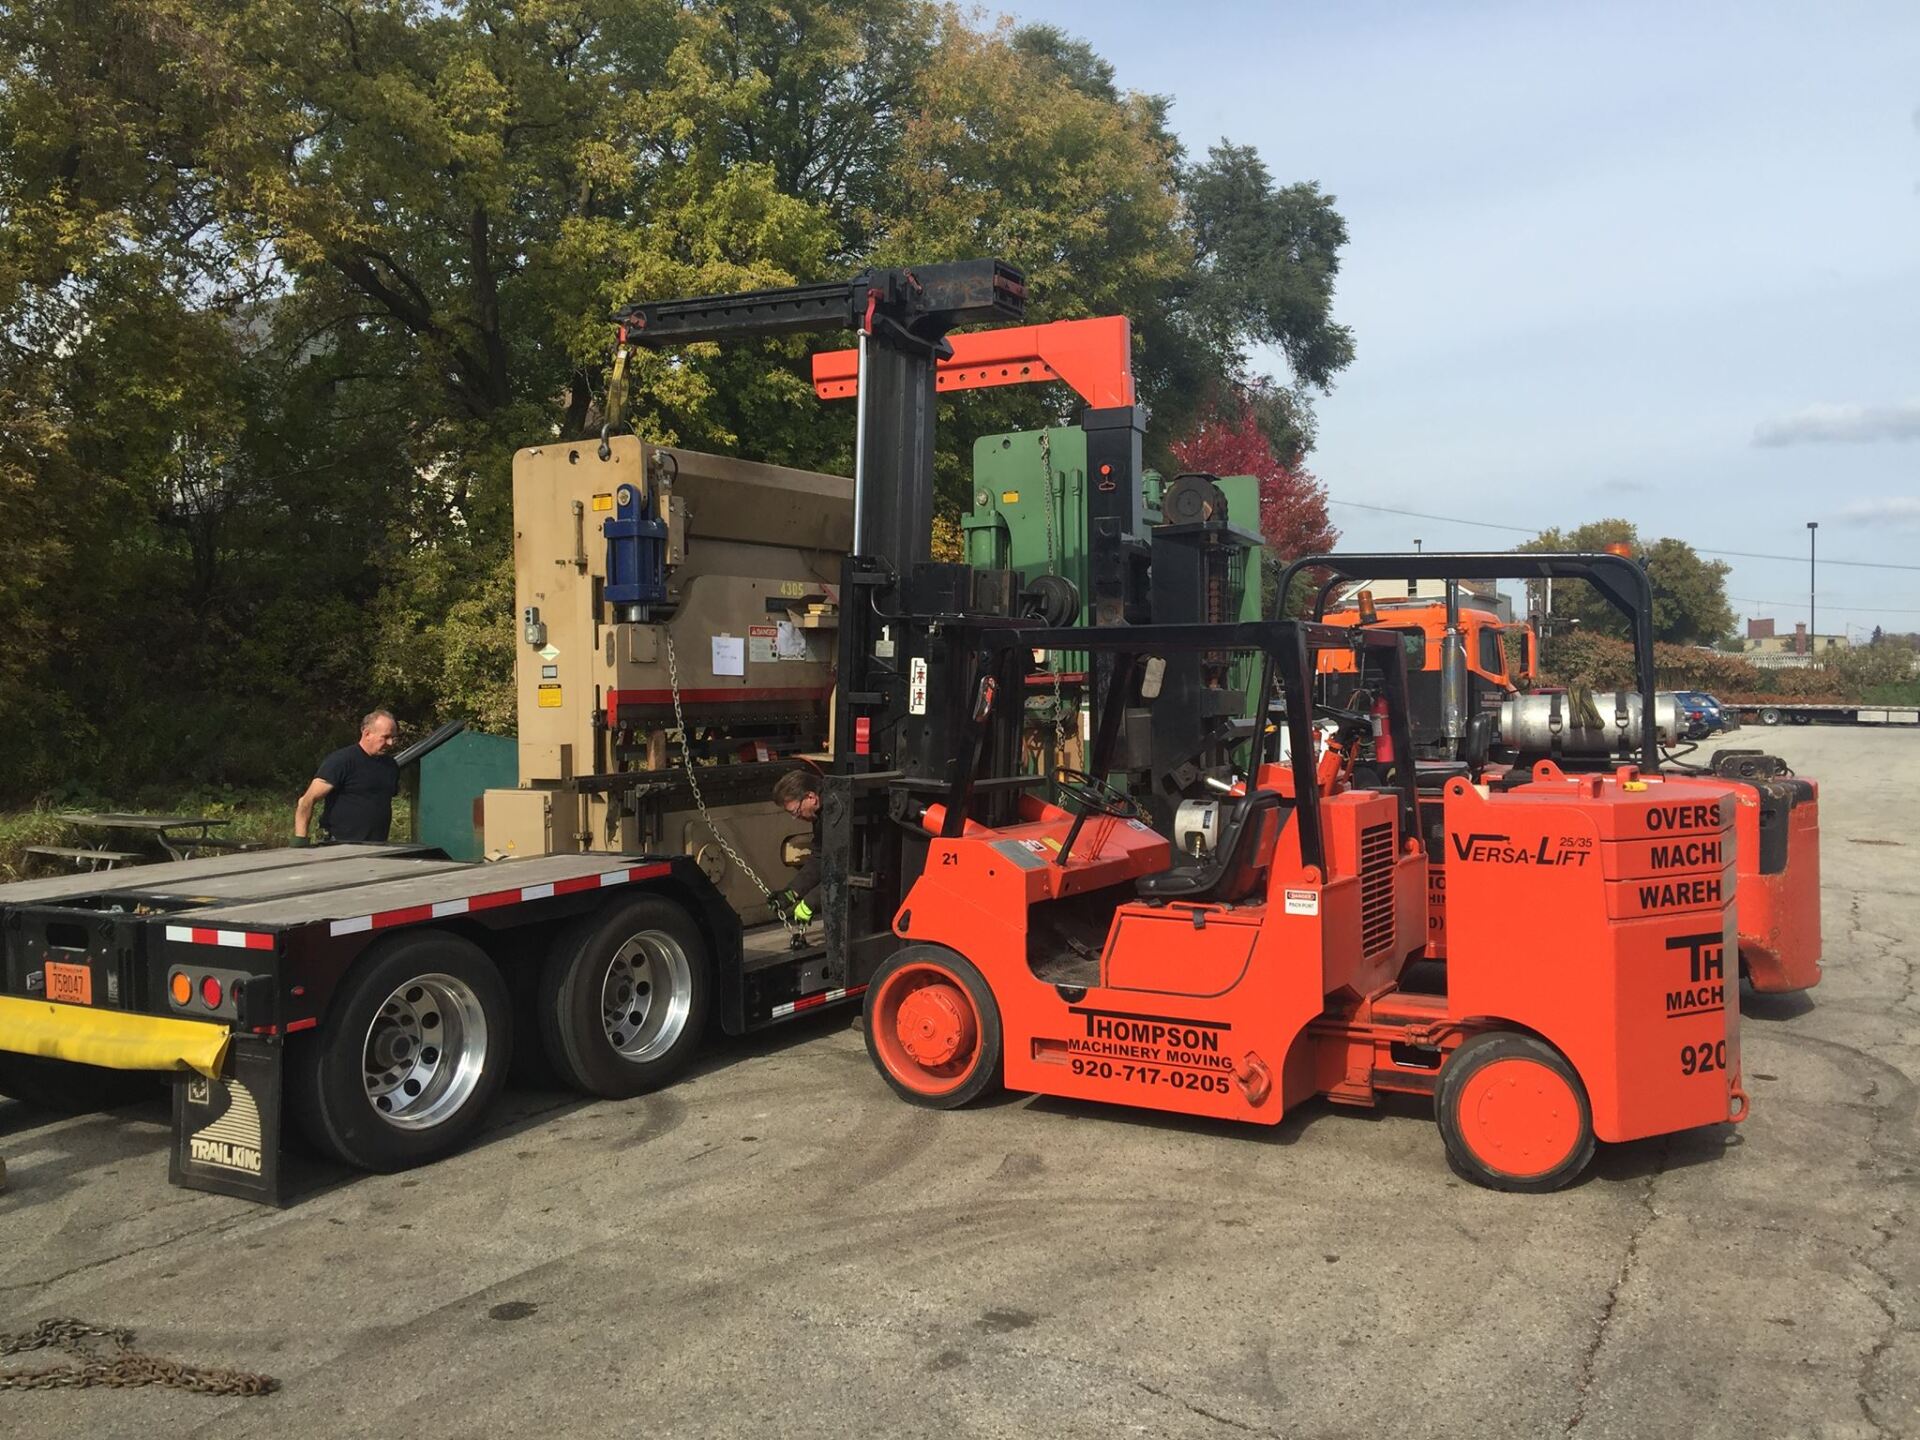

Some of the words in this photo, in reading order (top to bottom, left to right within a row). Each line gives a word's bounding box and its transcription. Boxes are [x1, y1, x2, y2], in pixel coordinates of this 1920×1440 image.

[780, 582, 805, 597] 4305
[1559, 837, 1593, 848] 25/35
[943, 852, 959, 866] 21
[52, 972, 84, 995] 758047
[1069, 1006, 1231, 1052] THOMPSON
[1068, 1038, 1160, 1061] MACHINERY
[1166, 1050, 1233, 1069] MOVING
[1071, 1058, 1230, 1094] 920-717-0205
